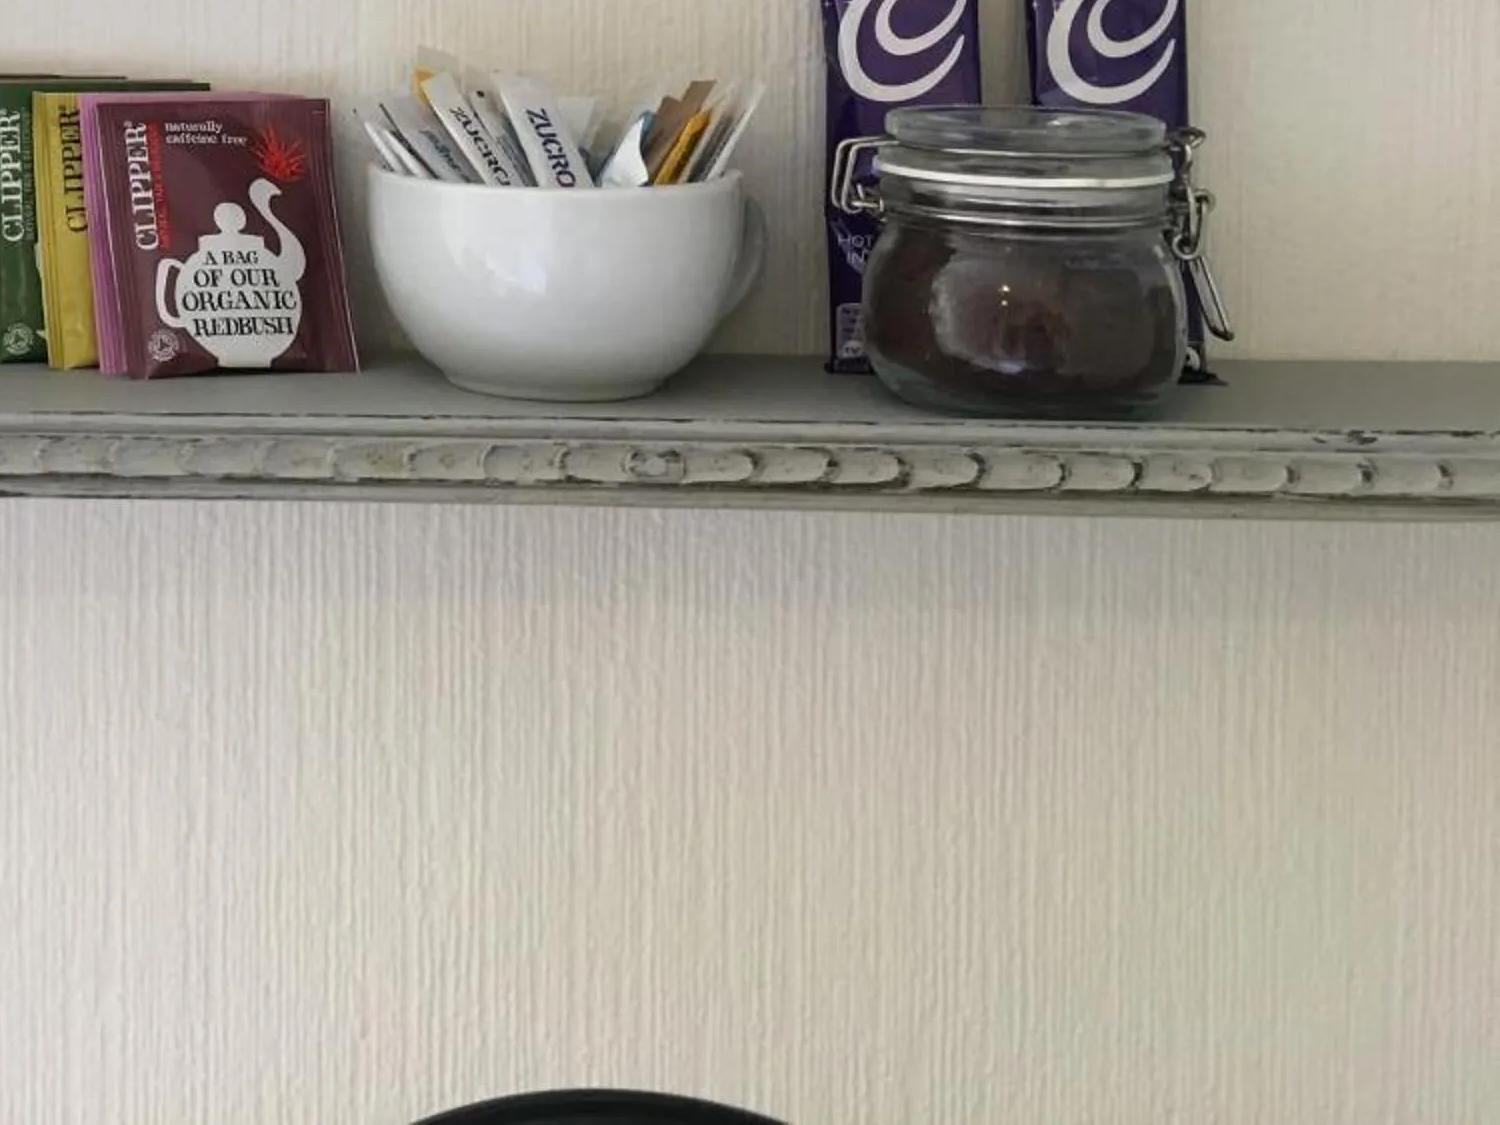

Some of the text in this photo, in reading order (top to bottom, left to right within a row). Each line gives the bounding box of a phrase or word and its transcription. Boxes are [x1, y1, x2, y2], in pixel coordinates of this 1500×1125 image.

[164, 120, 223, 134] naturally
[165, 133, 248, 146] caffeine free
[525, 107, 576, 188] ZUCRO
[124, 121, 160, 251] CLIPPER
[203, 250, 259, 266] A BAG
[193, 268, 280, 288] OF OUR
[182, 290, 297, 312] ORGANIC
[192, 316, 295, 337] REDBUSH
